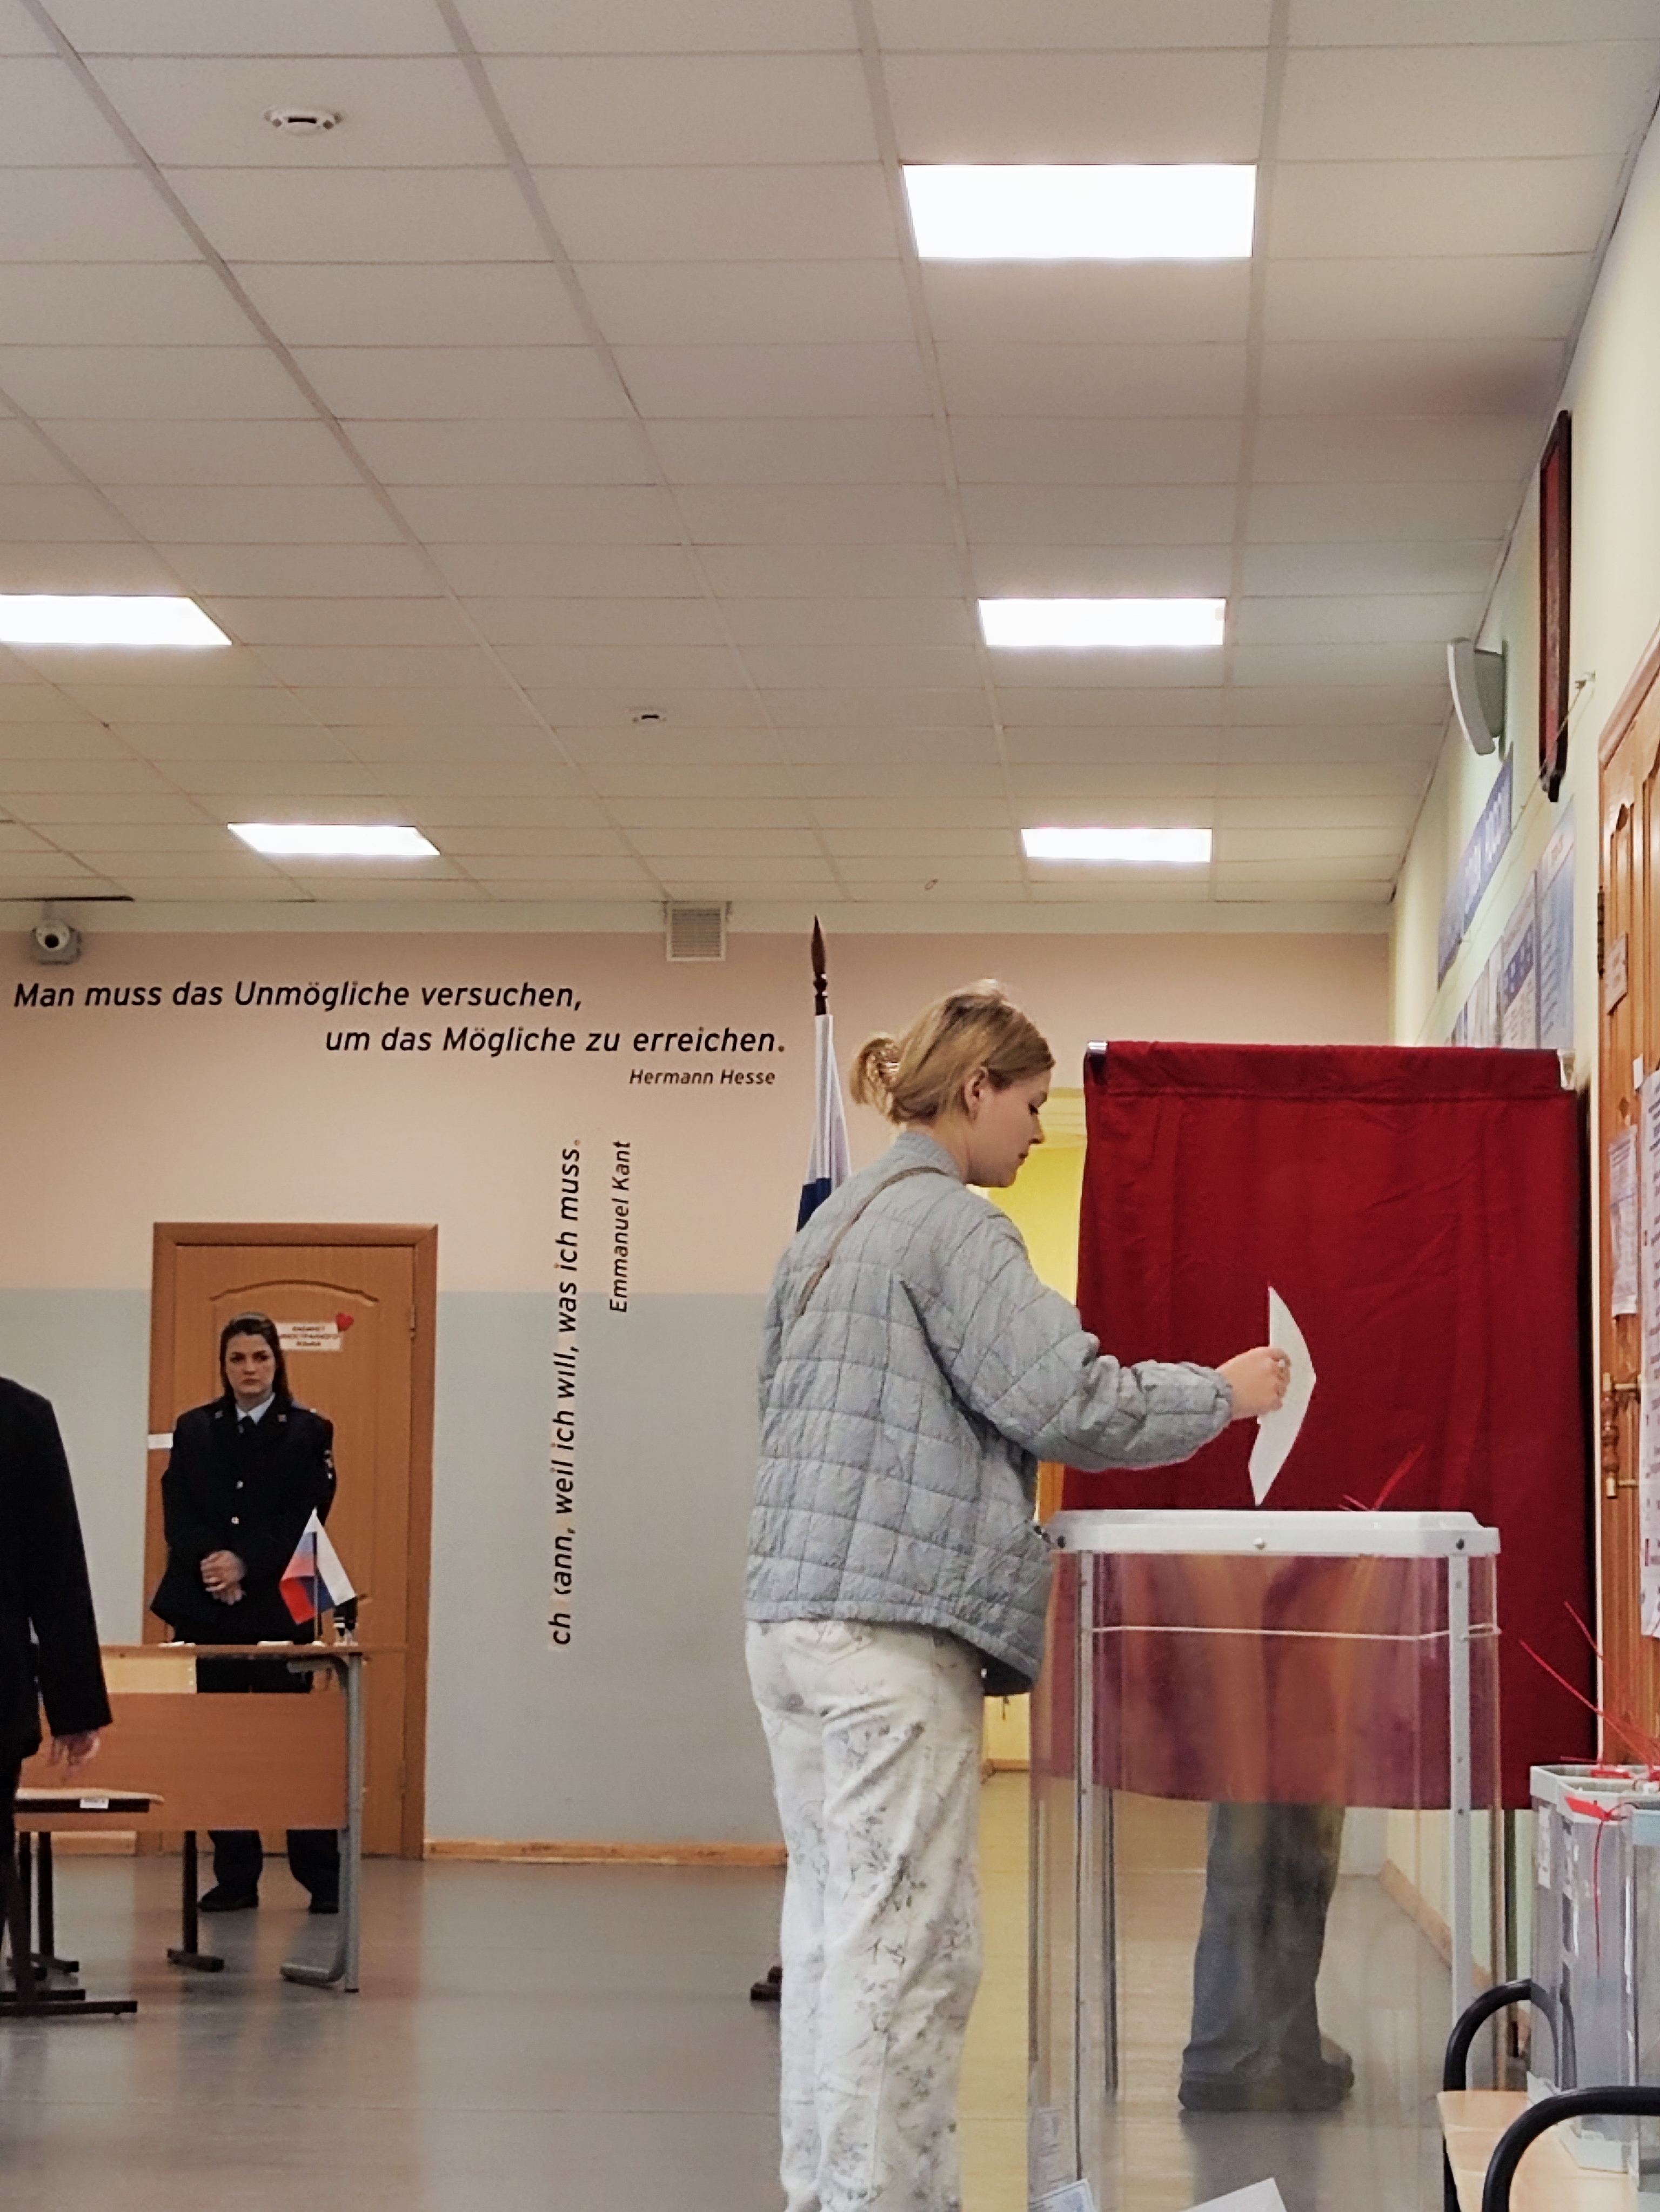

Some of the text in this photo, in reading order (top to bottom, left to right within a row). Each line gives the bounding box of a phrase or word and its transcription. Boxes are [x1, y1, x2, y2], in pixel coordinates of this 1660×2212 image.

[14, 980, 582, 1013] Man muss das Unmögliche versuchen,
[326, 1026, 785, 1058] um das Mögliche zu erreichen.
[629, 1068, 775, 1086] Hermann Hesse
[560, 1138, 581, 1222] muss.
[609, 1140, 631, 1313] Emmanuel Kant
[552, 1231, 578, 1272] ich
[558, 1281, 578, 1333] was
[552, 1345, 580, 1399] will,
[549, 1410, 575, 1451] ich
[548, 1459, 574, 1514] weil
[547, 1613, 571, 1645] ch
